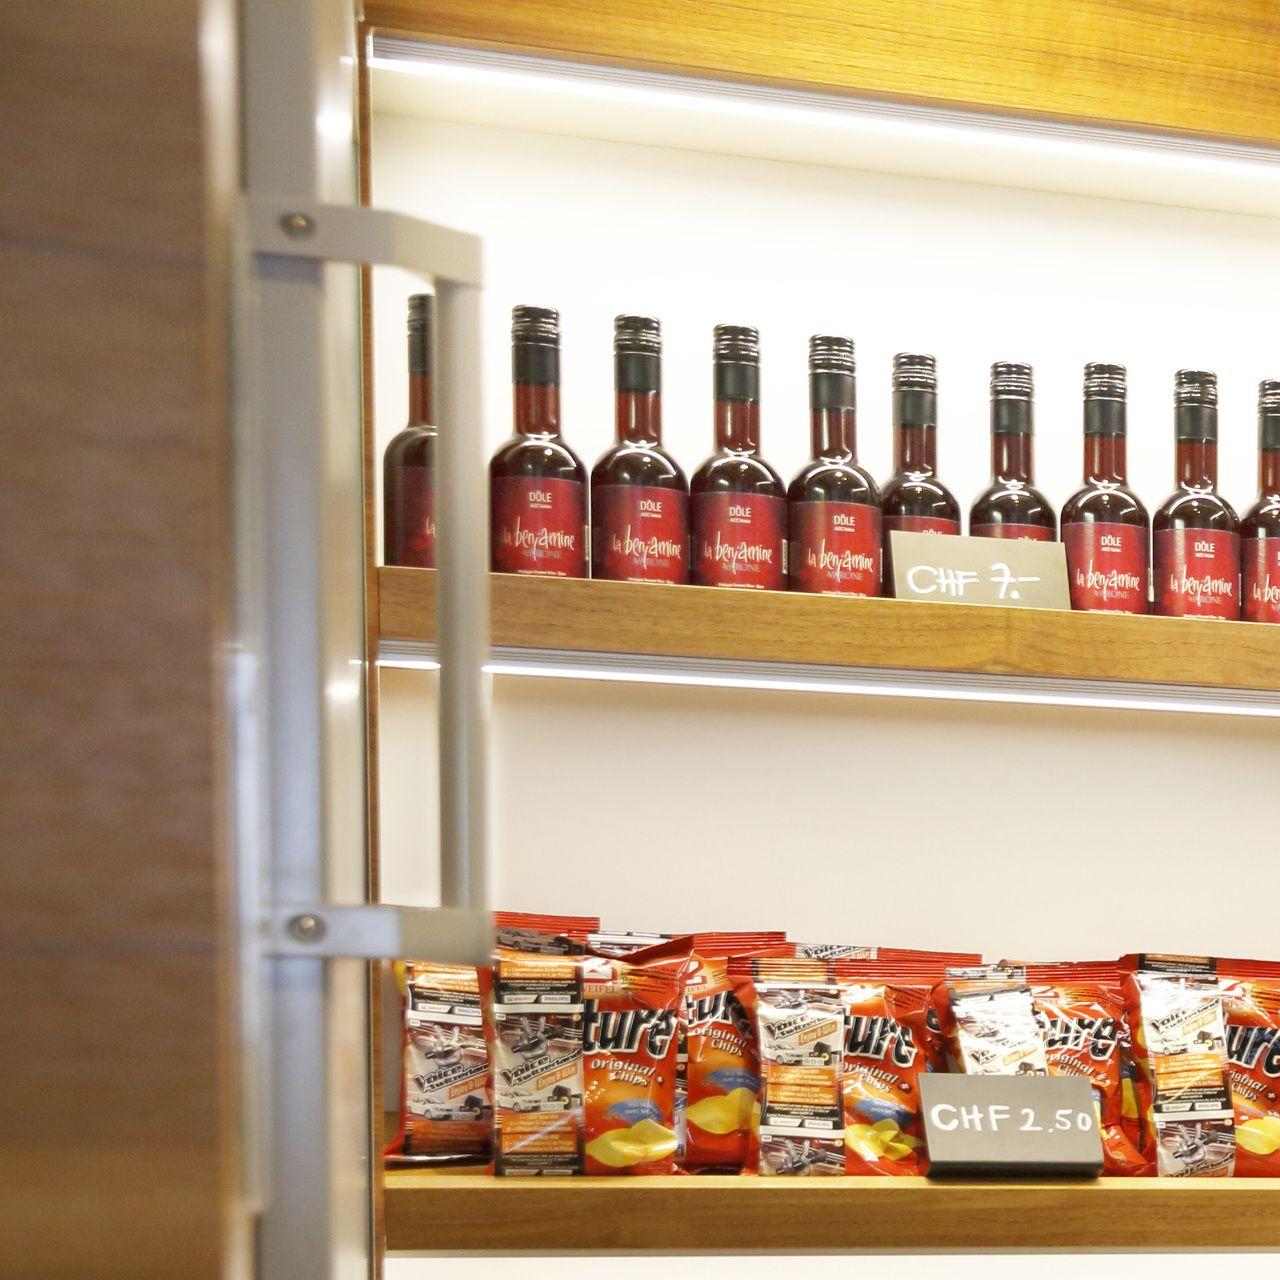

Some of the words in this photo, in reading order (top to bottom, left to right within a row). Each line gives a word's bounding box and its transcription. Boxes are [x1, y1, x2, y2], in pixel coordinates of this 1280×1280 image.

[529, 490, 552, 502] DÔLE
[640, 500, 662, 512] DÔLE
[730, 505, 751, 518] DÔLE
[834, 514, 855, 526] DÔLE
[1101, 534, 1122, 546] DÔLE
[1195, 540, 1215, 552] DÔLE
[907, 564, 979, 596] CHF
[591, 1058, 656, 1076] Original
[610, 1071, 649, 1086] Chips
[931, 1103, 1011, 1132] CHF
[1020, 1108, 1092, 1133] 2.50
